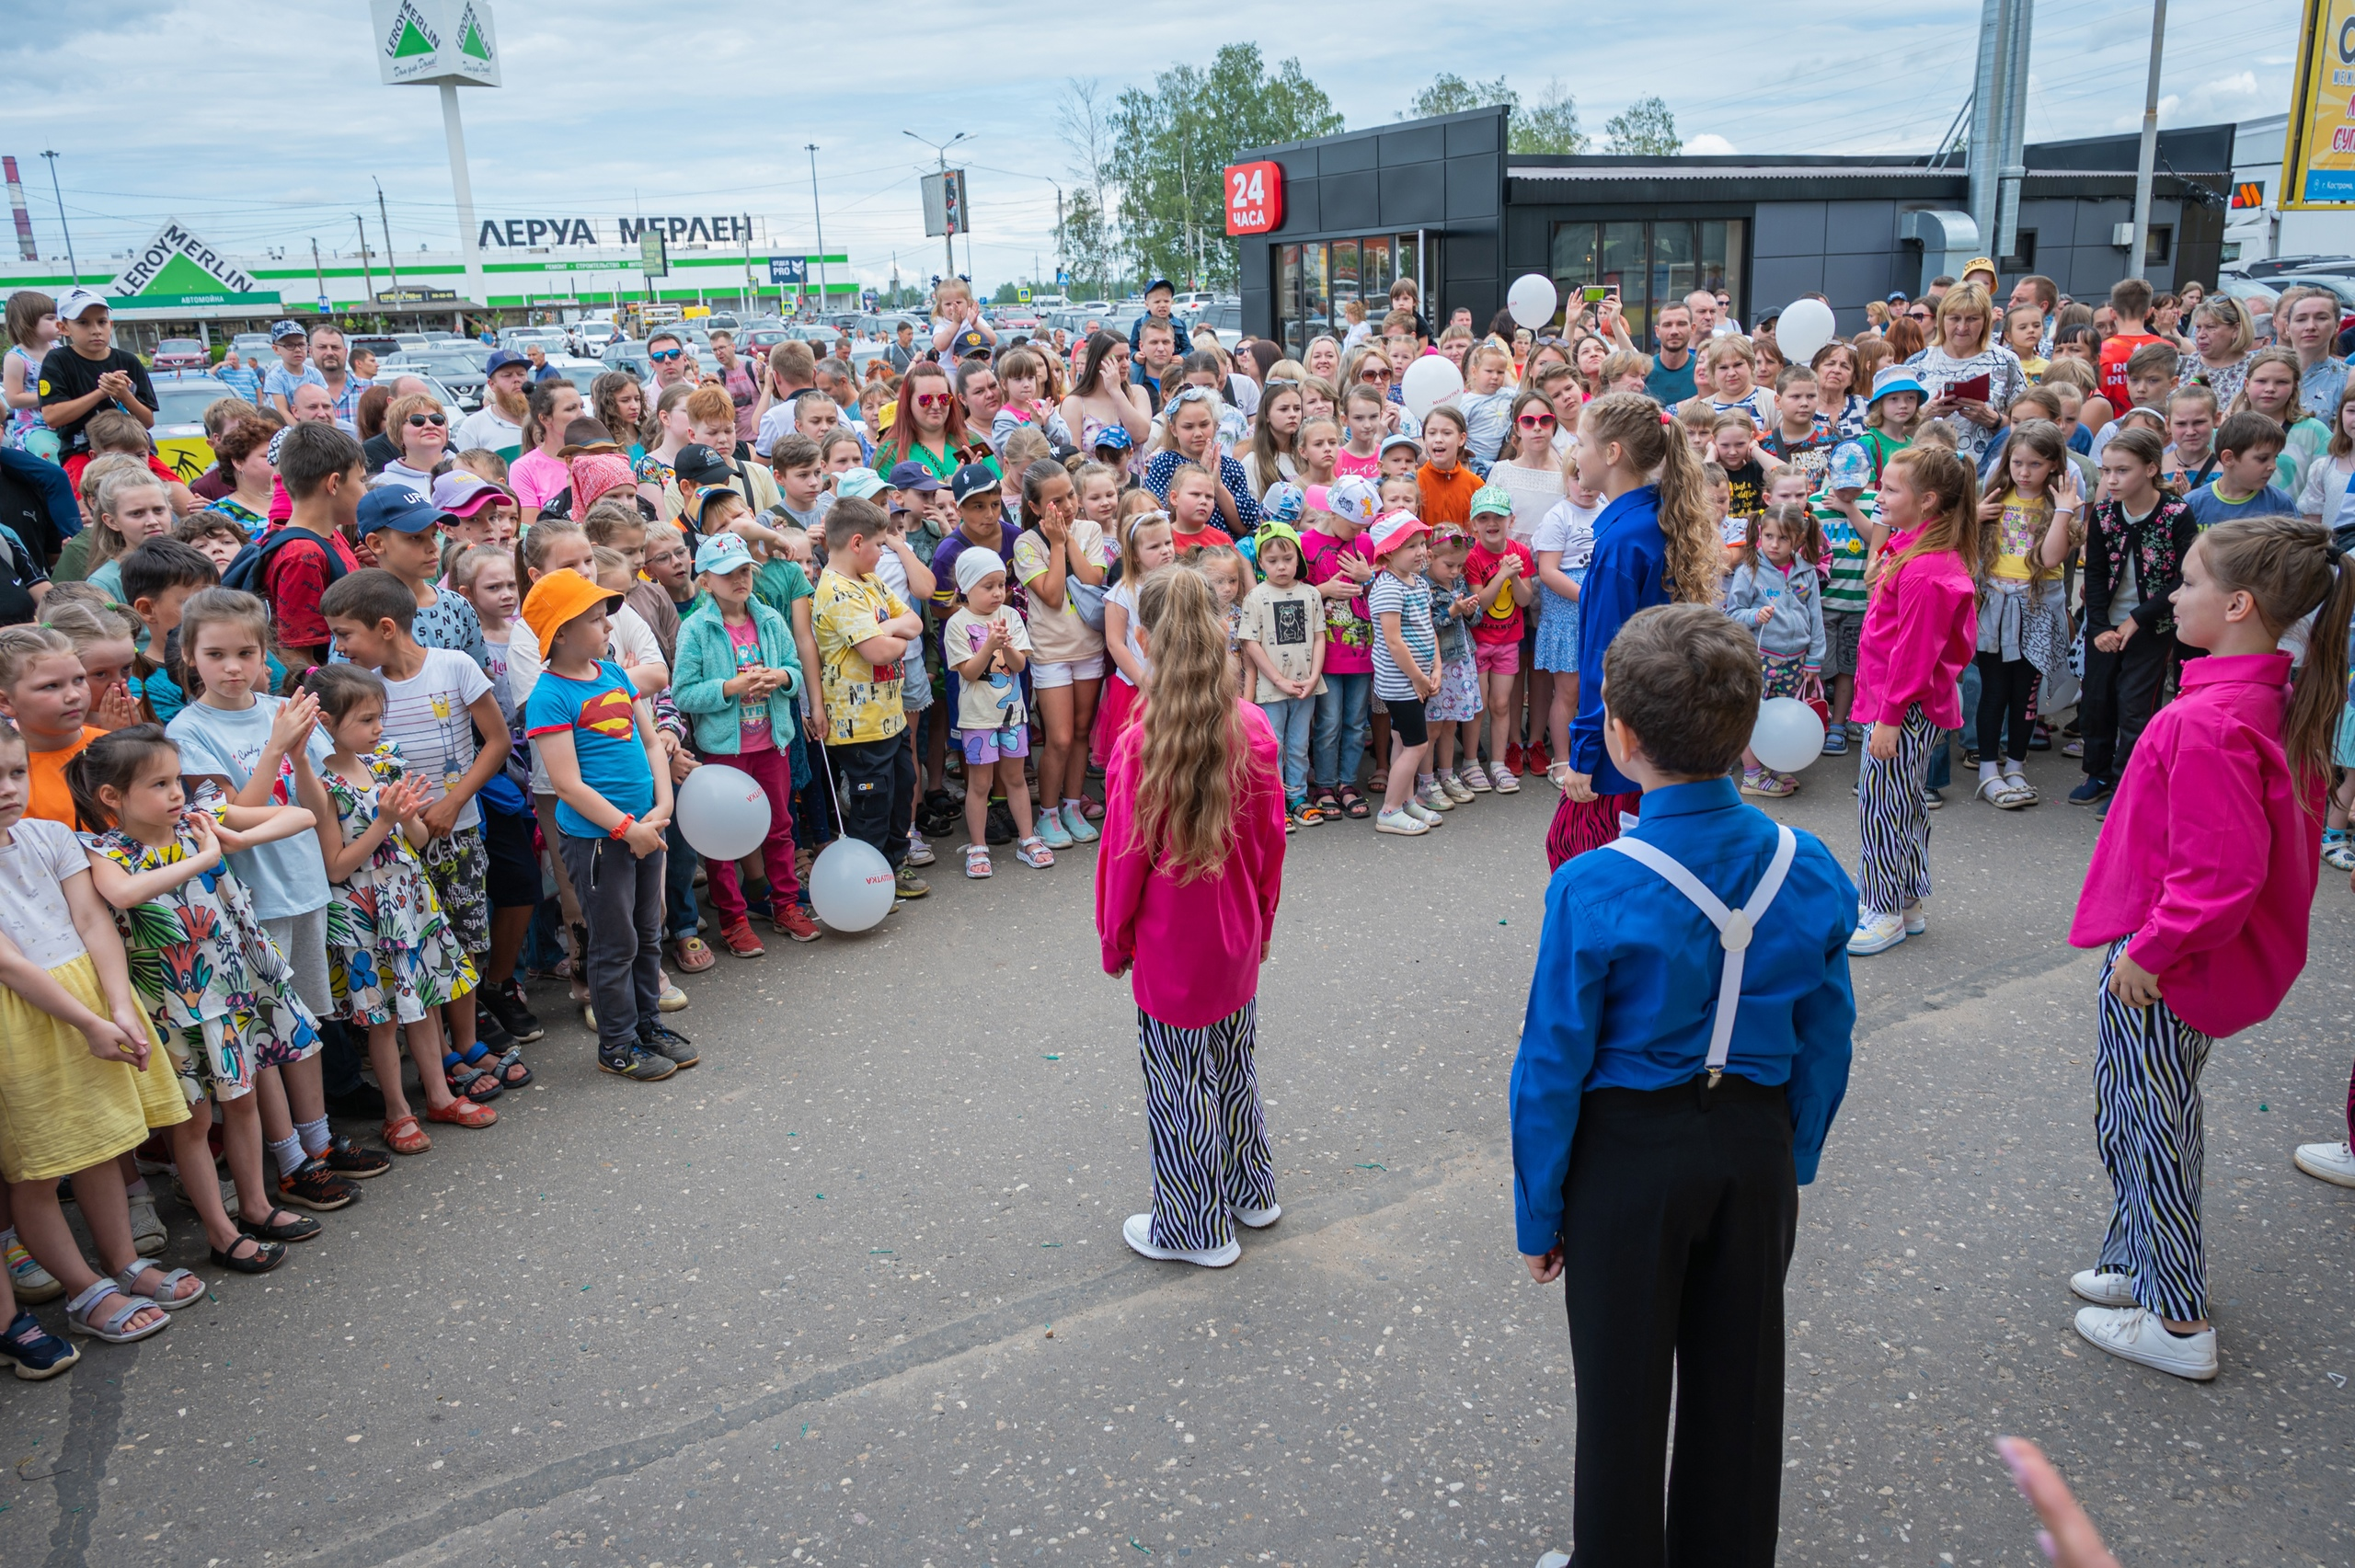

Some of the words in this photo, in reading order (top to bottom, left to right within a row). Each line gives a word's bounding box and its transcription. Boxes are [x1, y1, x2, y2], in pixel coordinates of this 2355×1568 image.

[385, 9, 406, 57] LEROY
[402, 0, 441, 49] MERLIN
[455, 11, 470, 50] LEROY
[465, 1, 493, 59] MERLIN
[1233, 169, 1265, 208] 24
[1233, 209, 1266, 228] ЧАСА
[478, 219, 597, 246] ЛЕРУА
[618, 216, 753, 244] МЕРЛЕН
[115, 237, 173, 297] LEROY
[164, 224, 254, 293] MERLIN
[773, 266, 790, 276] PRO
[181, 294, 224, 304] АВТОМОЙКА
[1432, 388, 1460, 406] МИШУТКА
[237, 743, 260, 761] Candy
